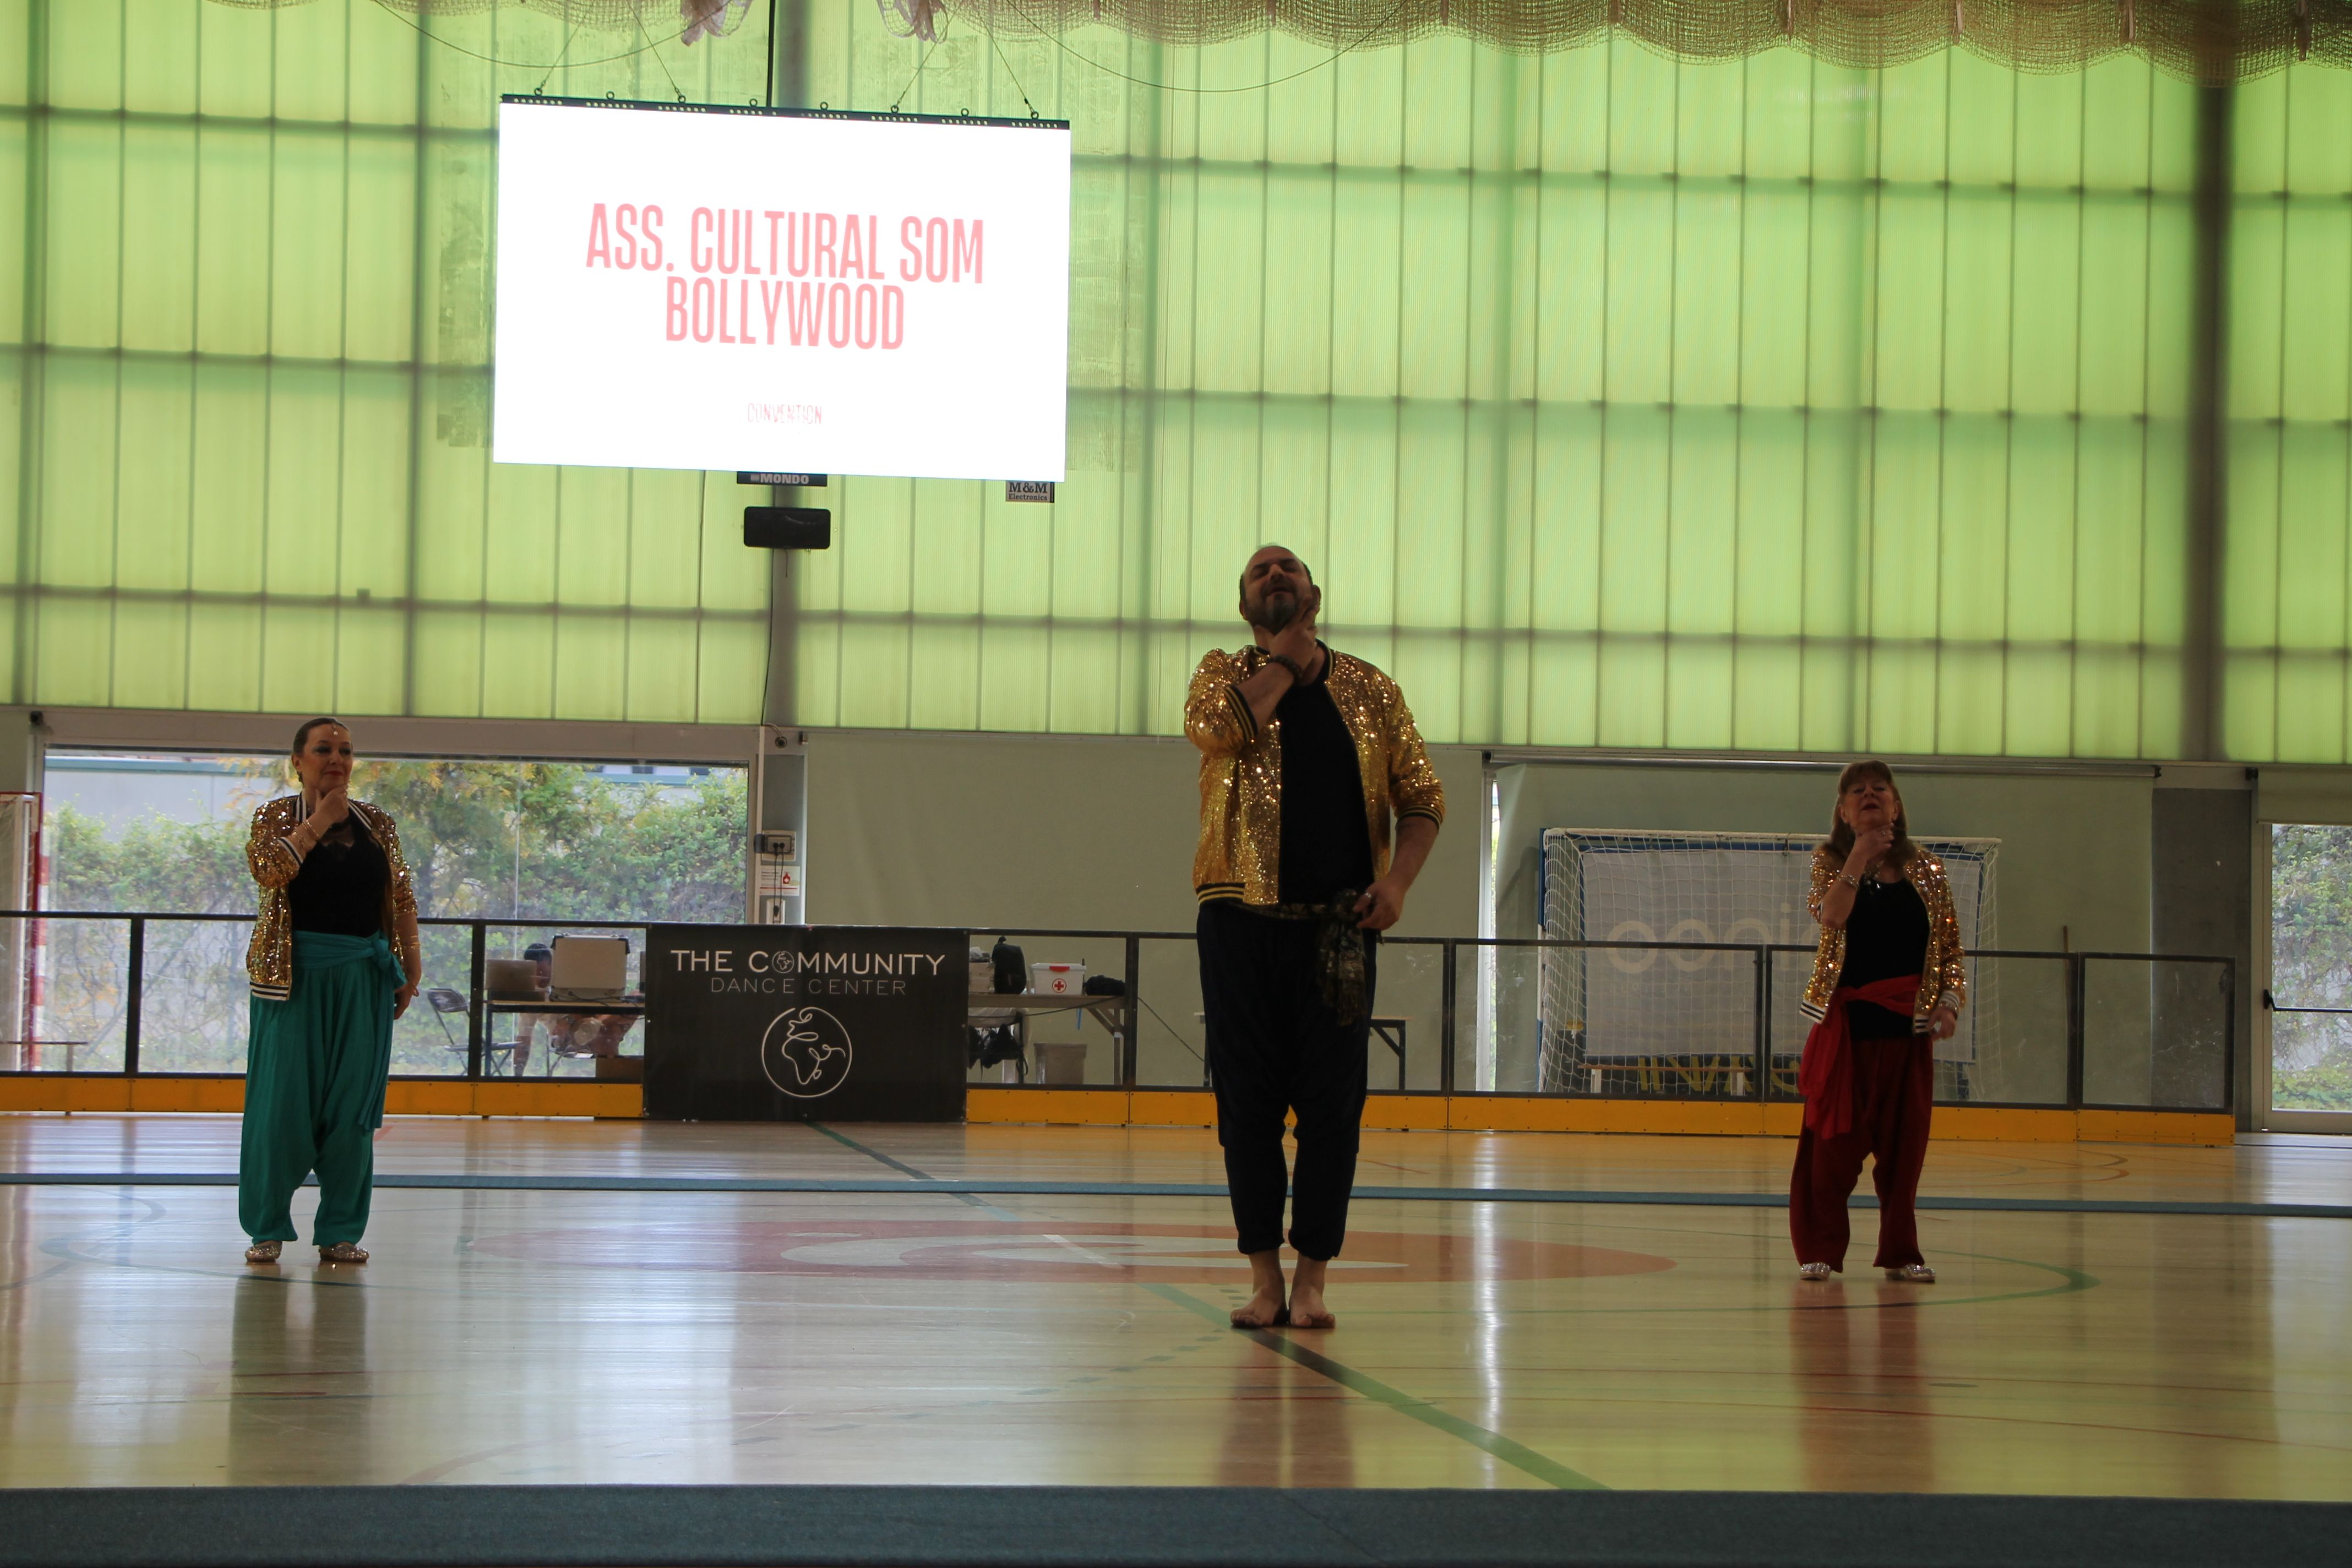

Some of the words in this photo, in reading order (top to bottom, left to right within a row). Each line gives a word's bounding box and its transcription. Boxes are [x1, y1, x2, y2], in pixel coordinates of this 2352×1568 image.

[586, 203, 674, 271] ASS.
[690, 206, 885, 280] CULTURAL
[900, 215, 983, 284] SOM
[666, 276, 904, 350] BOLLYWOOD
[748, 403, 822, 424] CONVENTION
[760, 473, 809, 484] MONDO
[1009, 482, 1048, 493] M&M
[670, 950, 733, 972] THE
[748, 951, 945, 976] COMMUNITY
[711, 977, 795, 993] DANCE
[808, 979, 906, 995] CENTER
